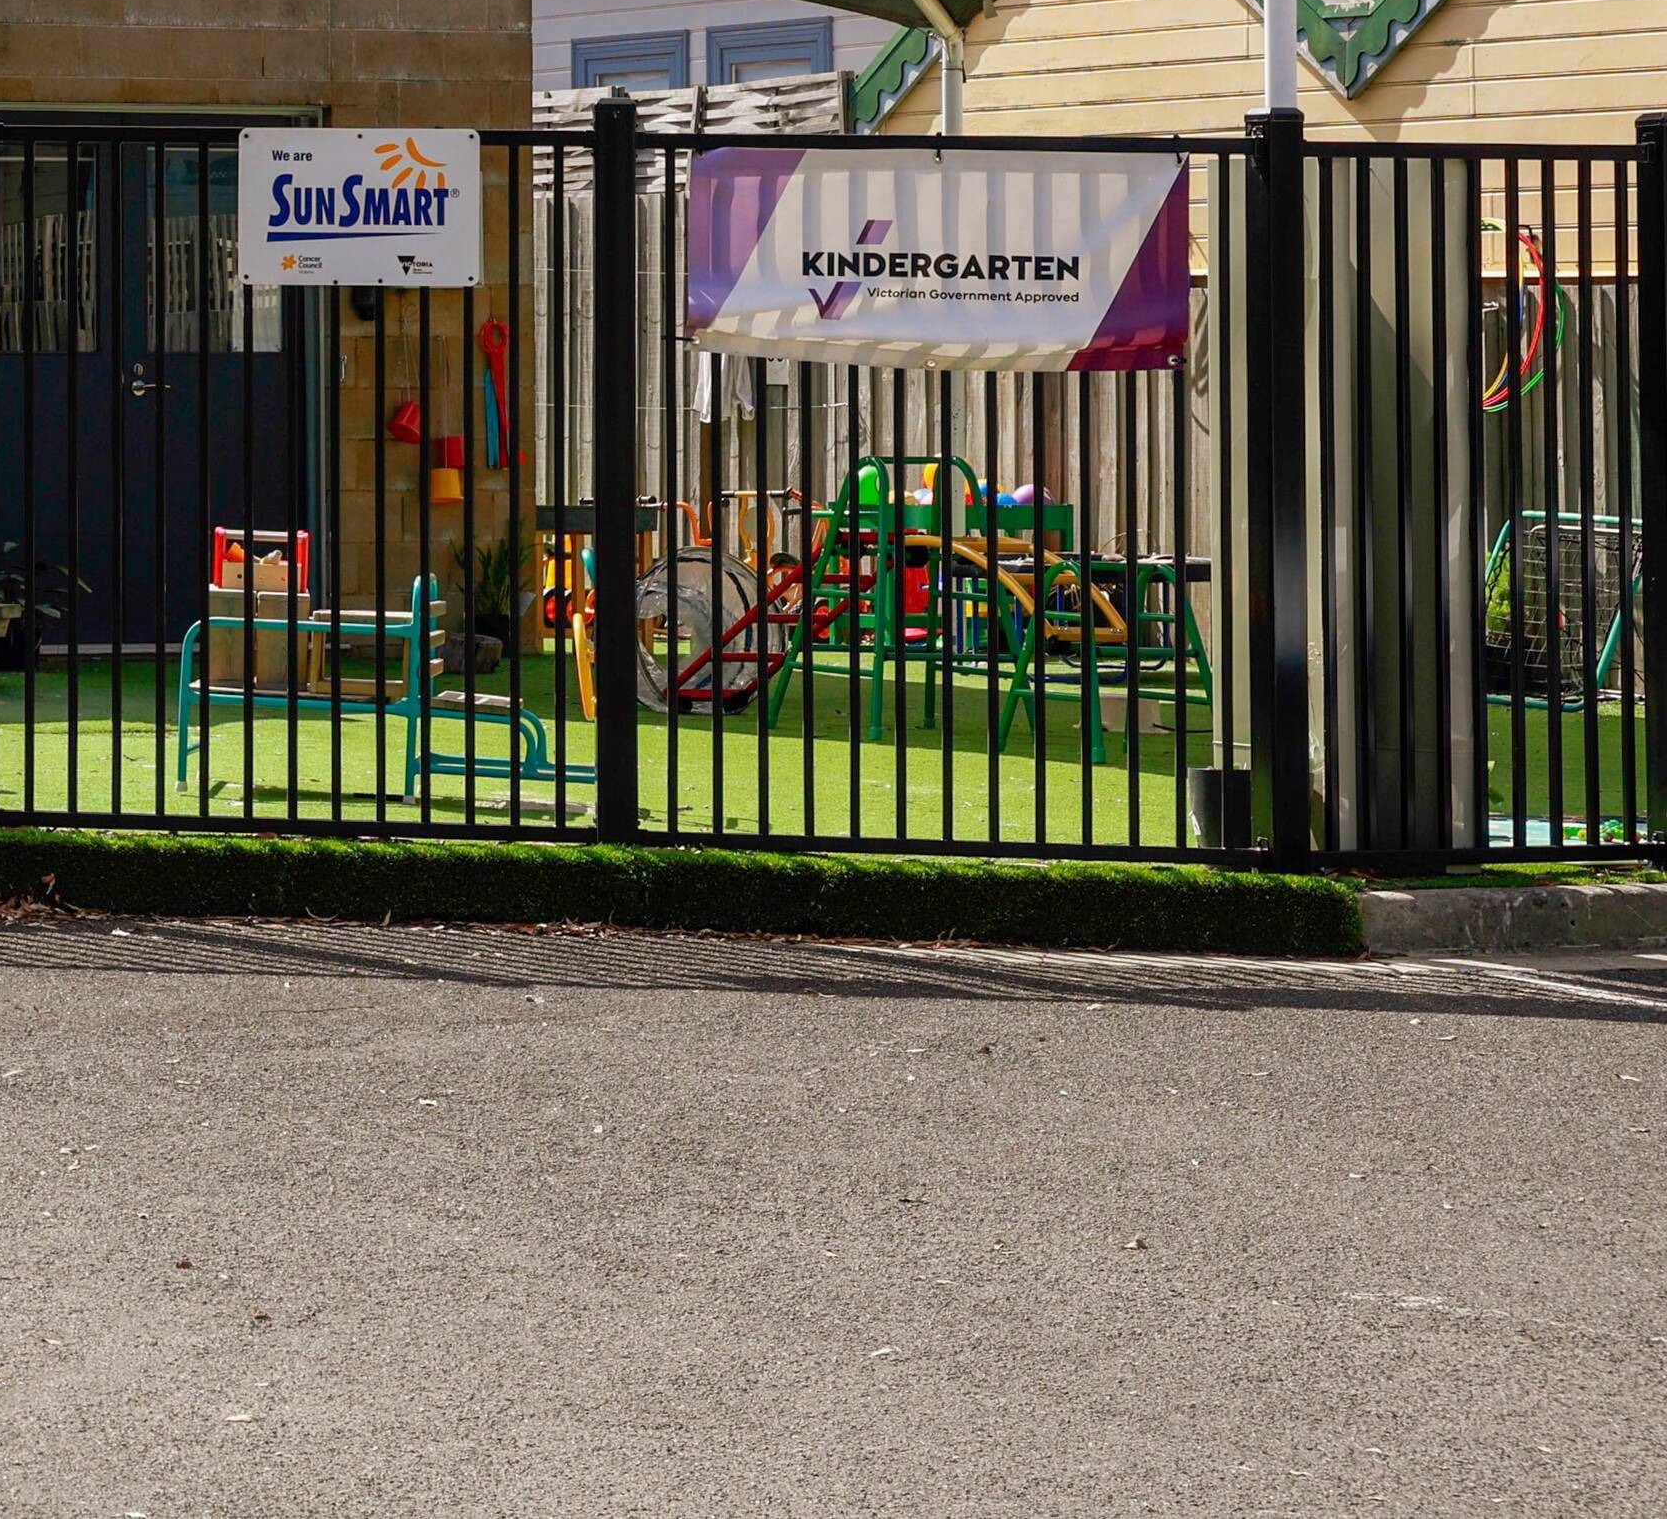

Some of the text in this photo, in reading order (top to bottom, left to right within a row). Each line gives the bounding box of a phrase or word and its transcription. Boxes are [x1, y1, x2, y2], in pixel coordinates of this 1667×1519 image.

[272, 150, 313, 161] We are
[802, 251, 1080, 281] KINDERGARTEN
[867, 287, 1079, 304] Victorian Government Approved
